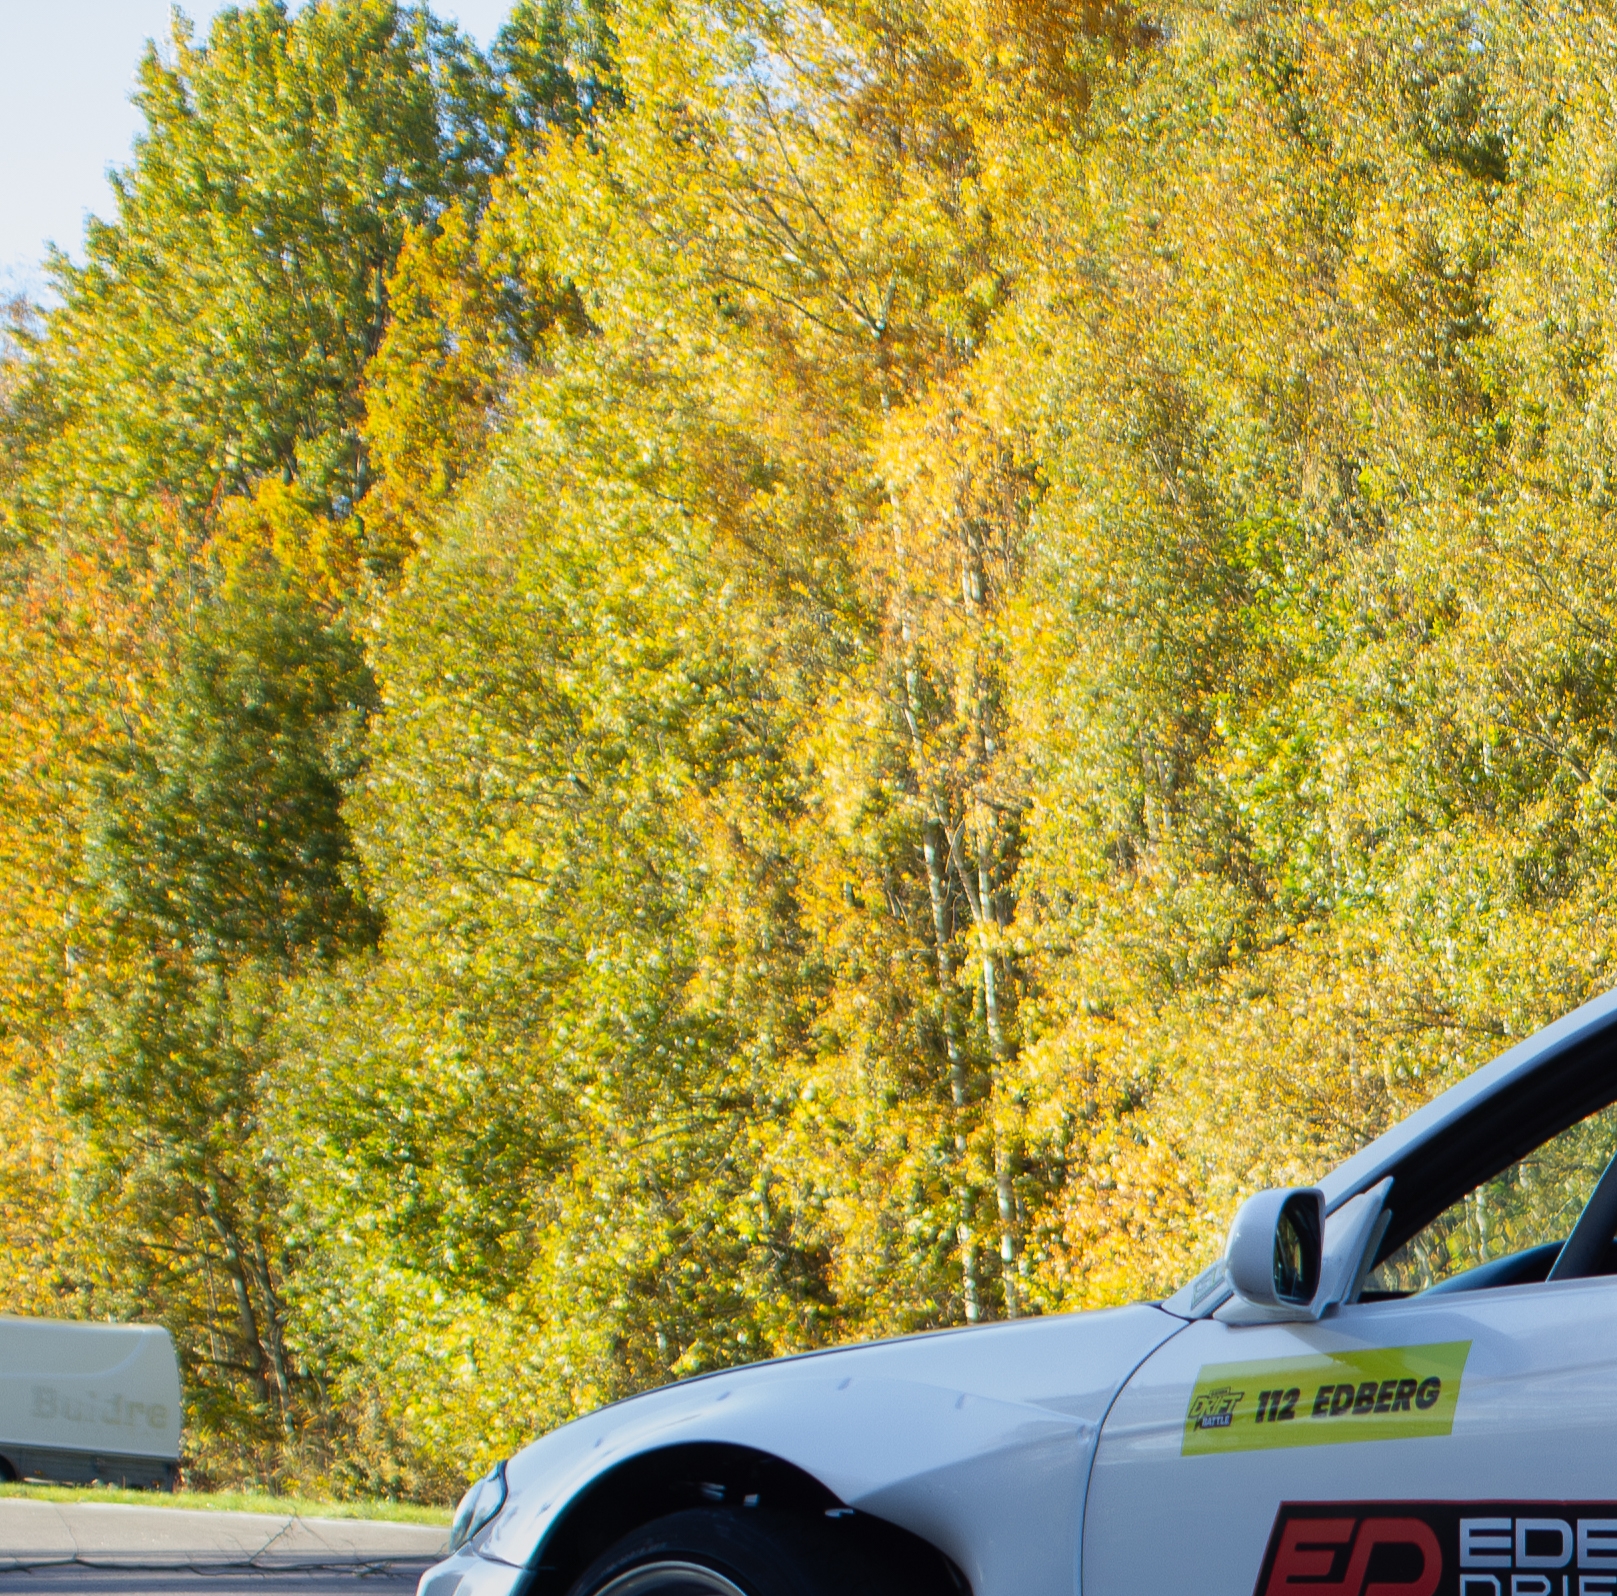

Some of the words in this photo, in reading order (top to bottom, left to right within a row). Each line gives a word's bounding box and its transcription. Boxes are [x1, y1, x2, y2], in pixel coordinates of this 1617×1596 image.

[1188, 1391, 1245, 1420] DRIFT
[1255, 1387, 1301, 1424] 112
[1311, 1376, 1442, 1419] EDBERG
[1201, 1414, 1231, 1428] BATTLE
